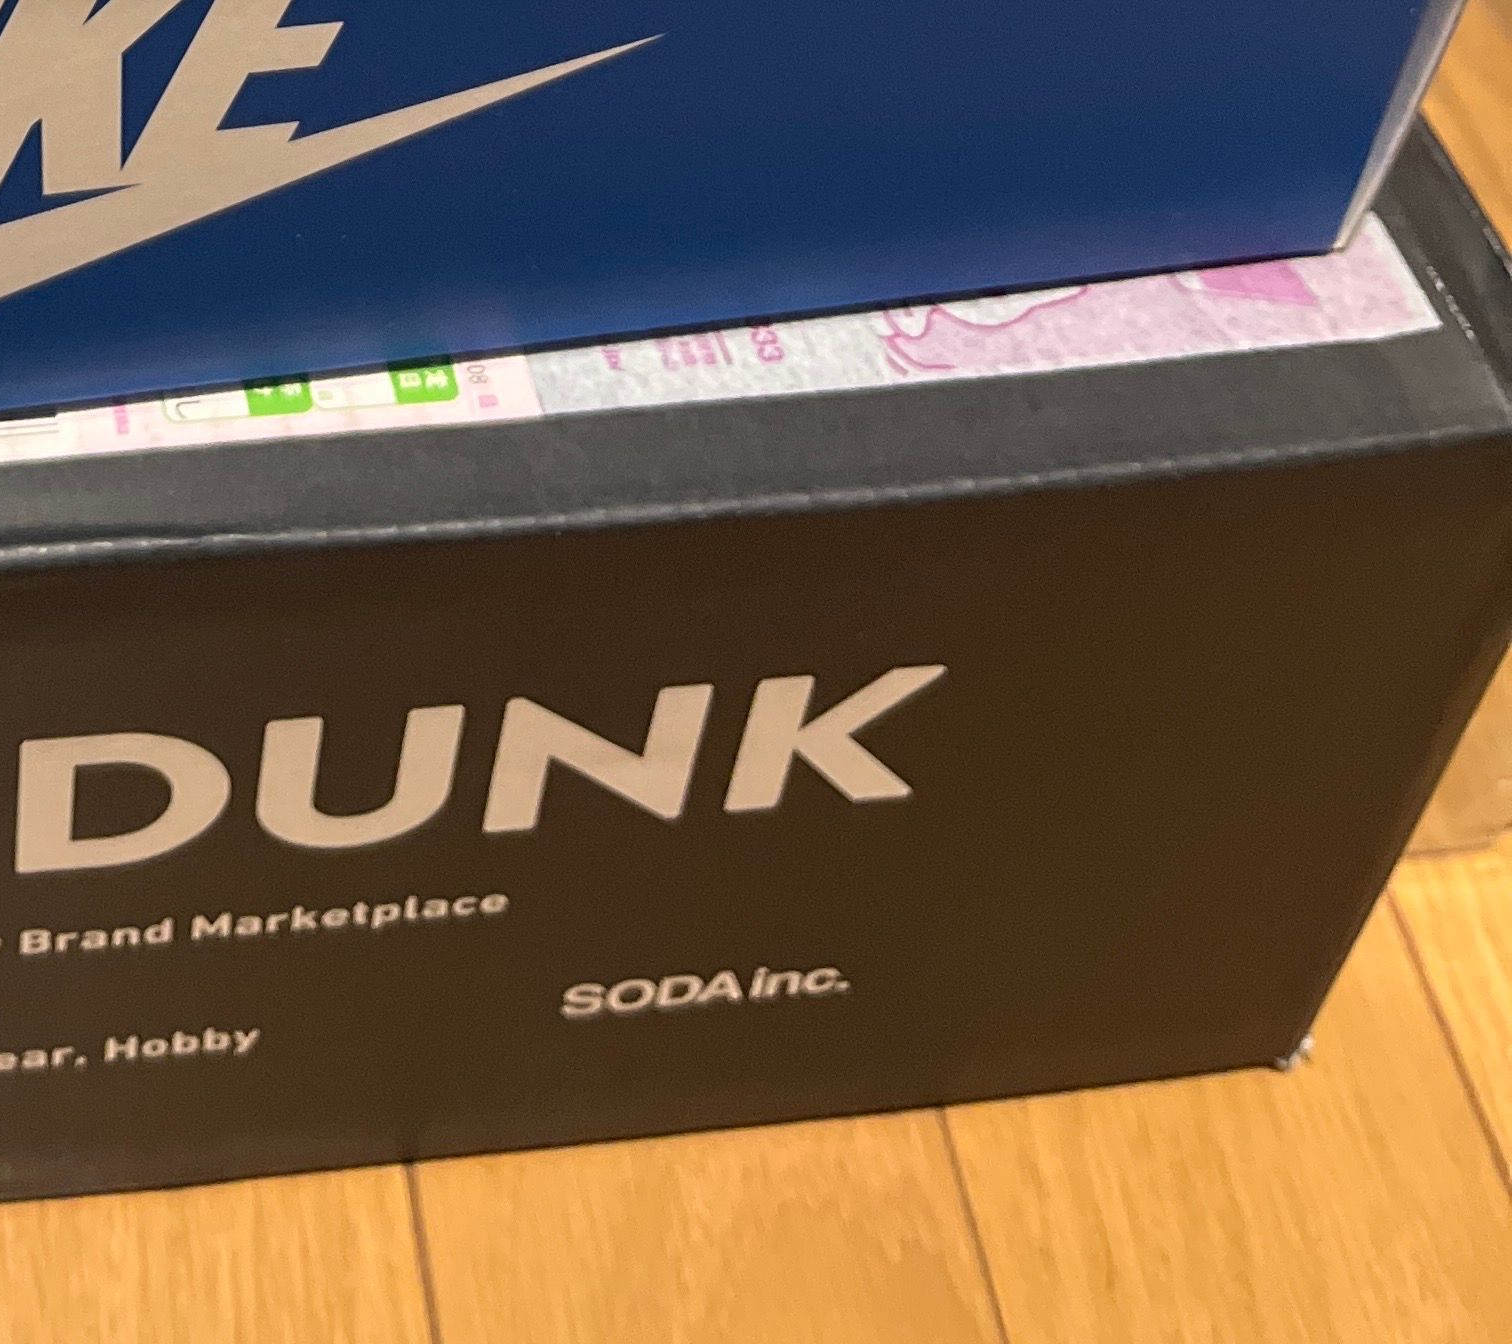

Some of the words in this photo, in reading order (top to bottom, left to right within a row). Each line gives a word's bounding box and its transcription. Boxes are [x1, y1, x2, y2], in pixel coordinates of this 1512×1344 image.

[19, 917, 174, 956] Brand
[190, 893, 509, 941] Marketplace
[560, 969, 743, 1019] SODA
[748, 965, 850, 1001] inc.
[103, 1027, 261, 1063] Hobby
